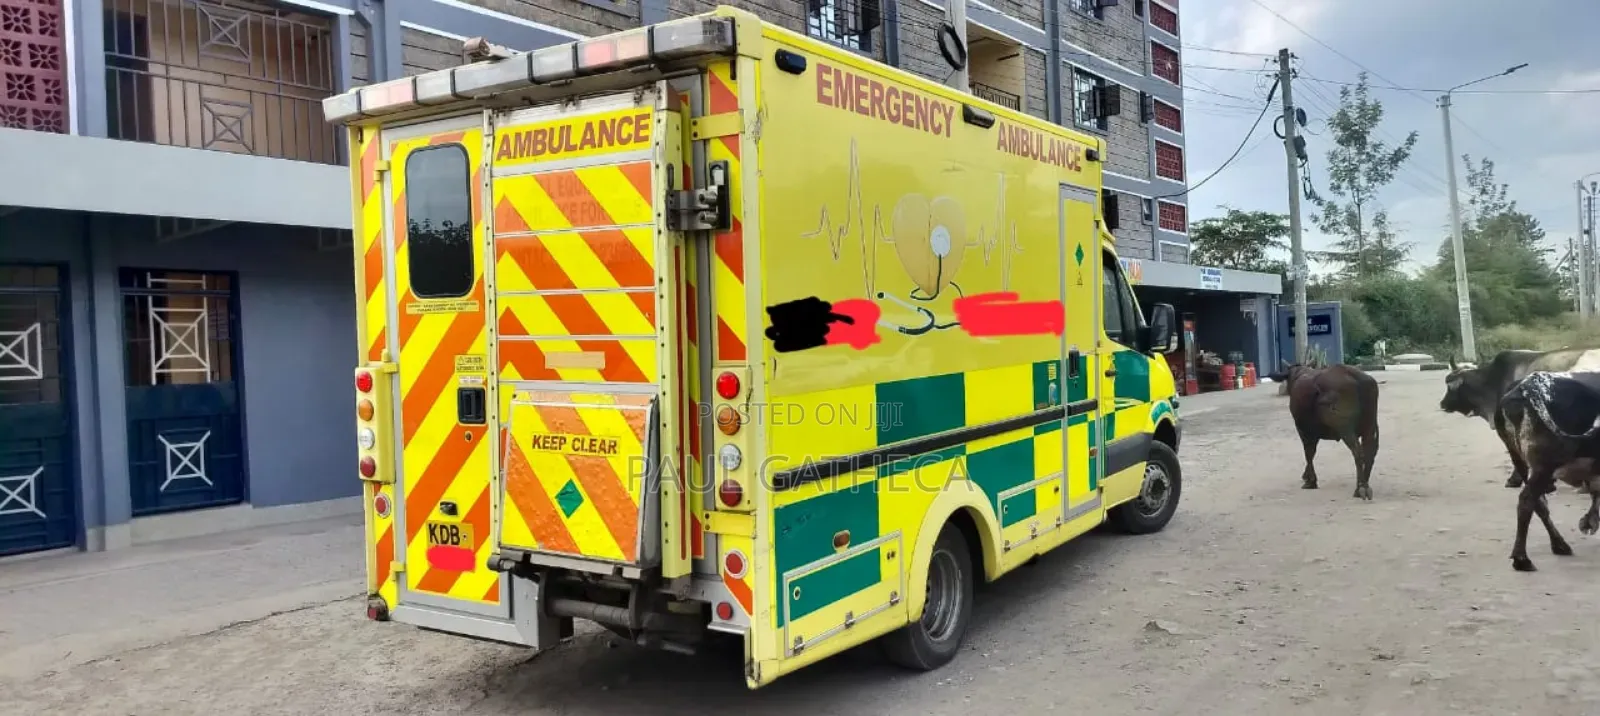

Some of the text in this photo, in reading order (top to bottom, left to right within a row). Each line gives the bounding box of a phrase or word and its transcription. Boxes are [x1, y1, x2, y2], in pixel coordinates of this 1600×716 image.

[816, 63, 1082, 172] EMERGENCY AMBULANCE
[496, 113, 651, 161] AMBULANCE
[532, 434, 618, 454] KEEP CLEAR
[428, 523, 461, 546] KDB
